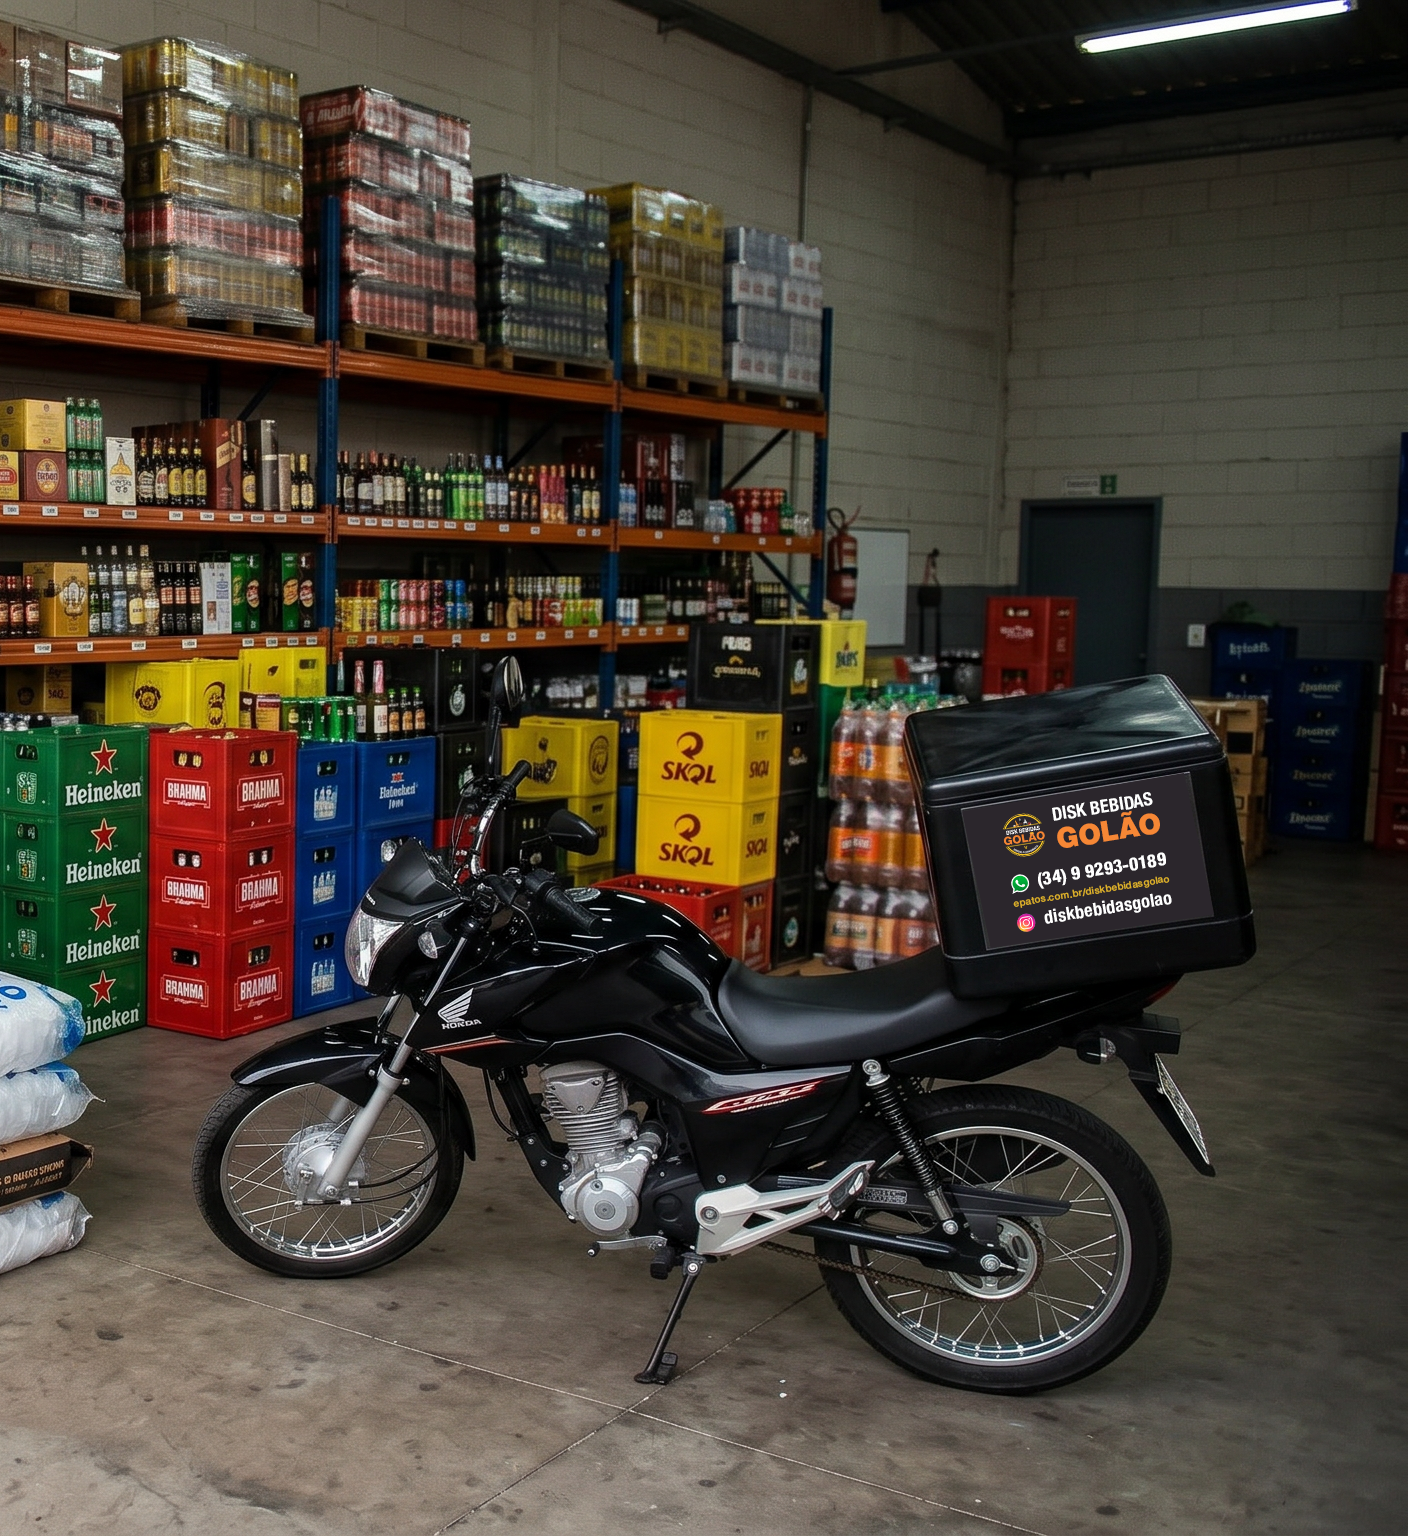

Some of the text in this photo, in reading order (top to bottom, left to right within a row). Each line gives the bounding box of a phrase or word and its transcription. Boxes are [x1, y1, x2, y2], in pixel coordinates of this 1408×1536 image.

[661, 761, 717, 786] SKOL
[65, 780, 142, 806] Heineken
[242, 778, 280, 803] BRAHMA
[1052, 791, 1153, 822] DISK BEBIDAS
[1056, 810, 1161, 849] GOLÃO
[658, 842, 714, 868] SKOL
[66, 857, 141, 885] Heineken
[1037, 852, 1167, 889] (34) 9 9293-0189
[241, 877, 278, 902] BRAHMA
[1043, 892, 1173, 926] diskbebidasgolao
[65, 935, 140, 964] Heineken
[240, 974, 277, 1001] BRAHMA
[85, 1008, 140, 1036] ineken
[441, 1019, 482, 1030] HONDA
